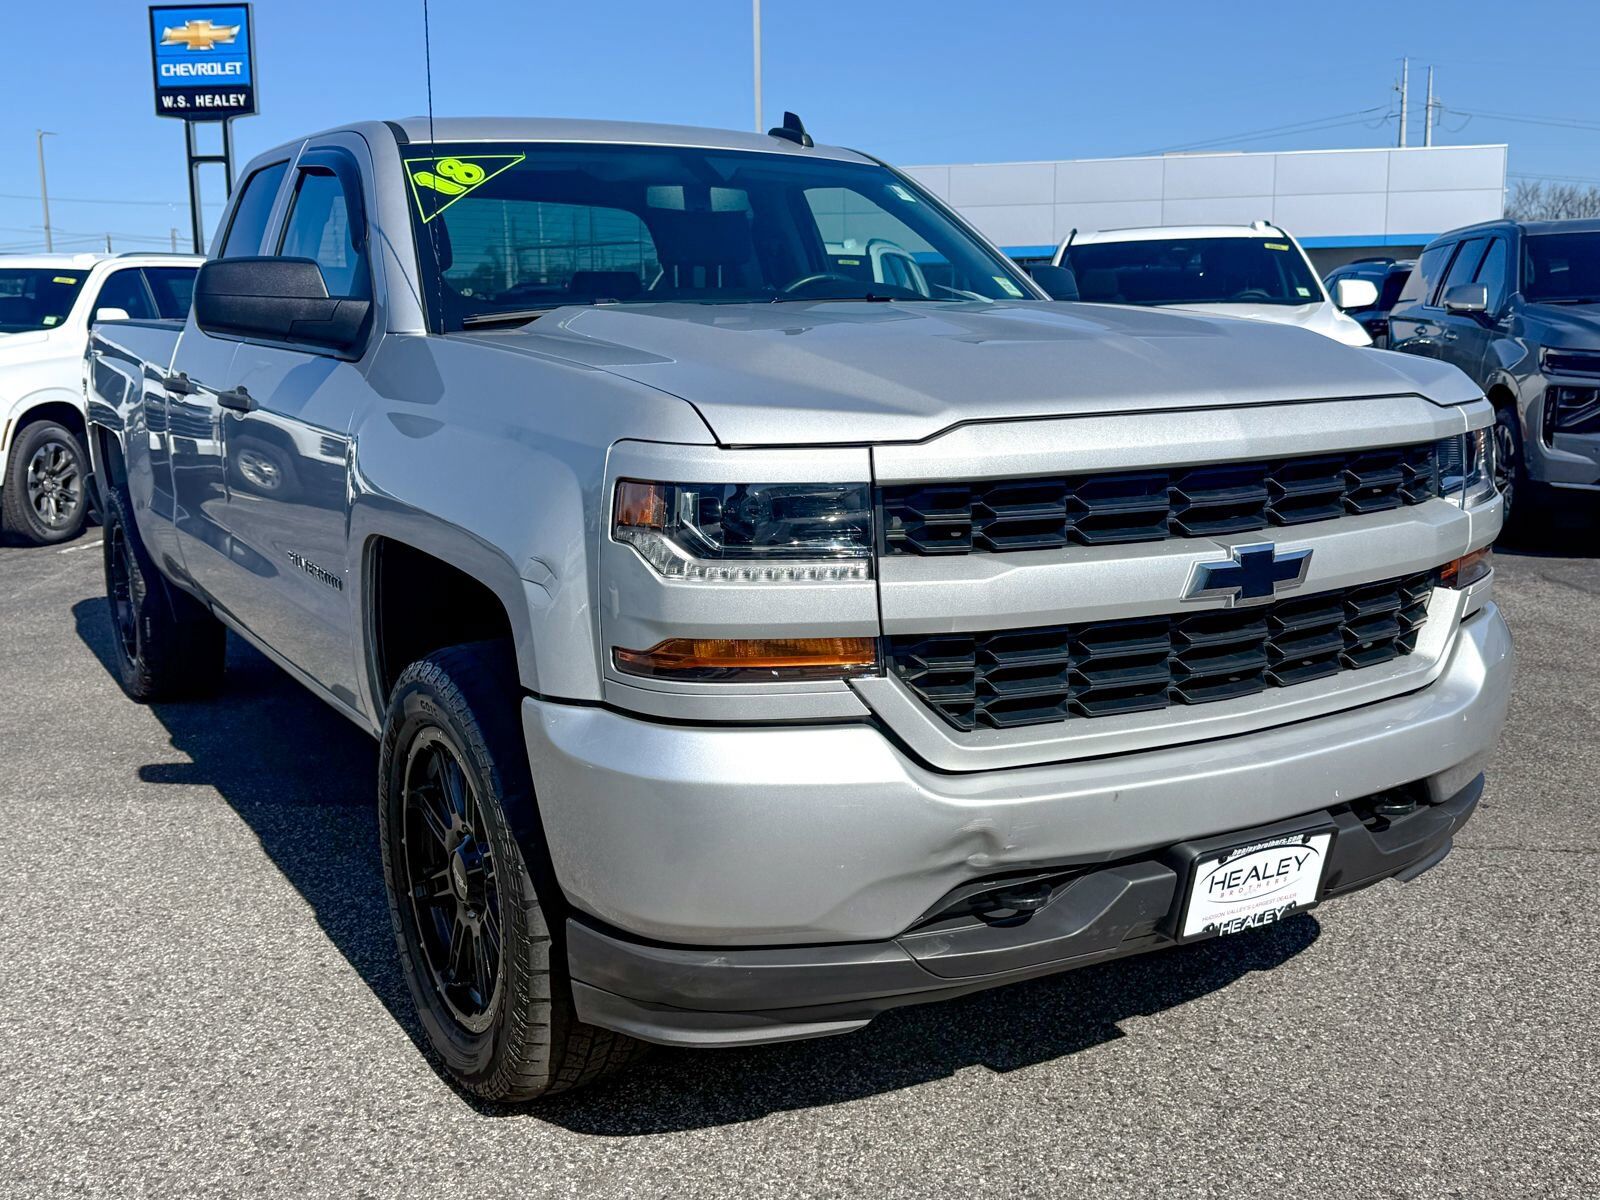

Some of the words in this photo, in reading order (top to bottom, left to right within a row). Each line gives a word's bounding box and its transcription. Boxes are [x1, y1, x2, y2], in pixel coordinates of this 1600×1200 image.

[161, 61, 243, 77] CHEVROLET
[162, 95, 191, 108] W.S.
[195, 94, 246, 107] HEALEY
[412, 158, 486, 195] 18
[1208, 852, 1310, 894] HEALEY
[1220, 876, 1289, 899] BROTHERS
[1219, 906, 1285, 937] HEALEY
